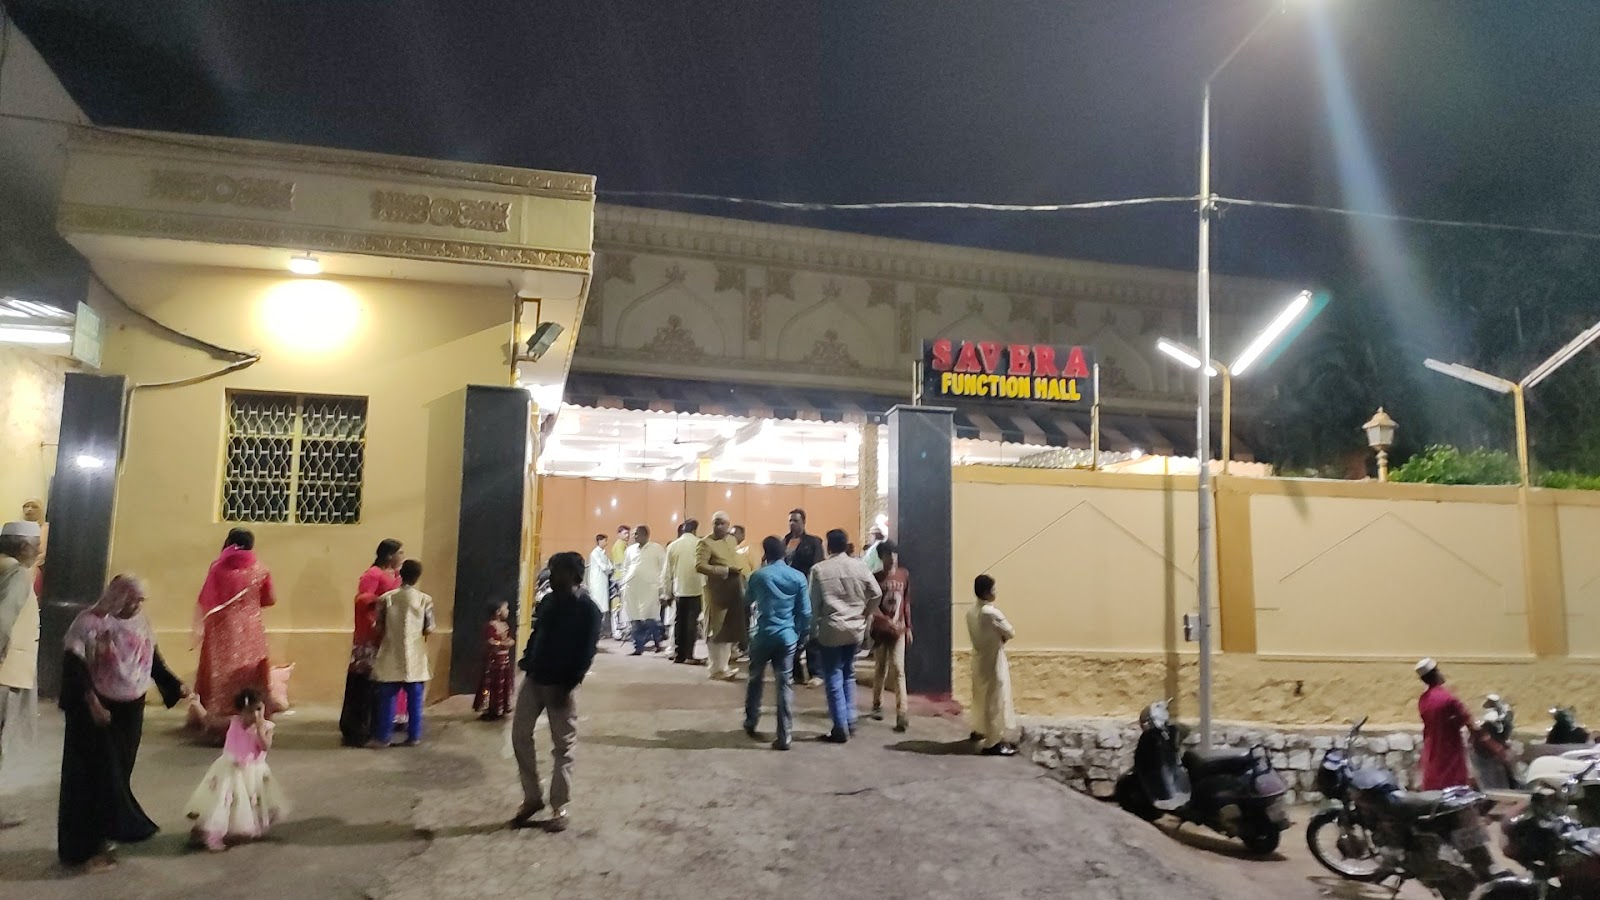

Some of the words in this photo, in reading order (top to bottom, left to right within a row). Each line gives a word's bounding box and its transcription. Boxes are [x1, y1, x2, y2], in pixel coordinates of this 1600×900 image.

[932, 338, 1089, 377] SAVERA
[941, 372, 1031, 398] FUNCTION
[1034, 377, 1081, 400] HALL
